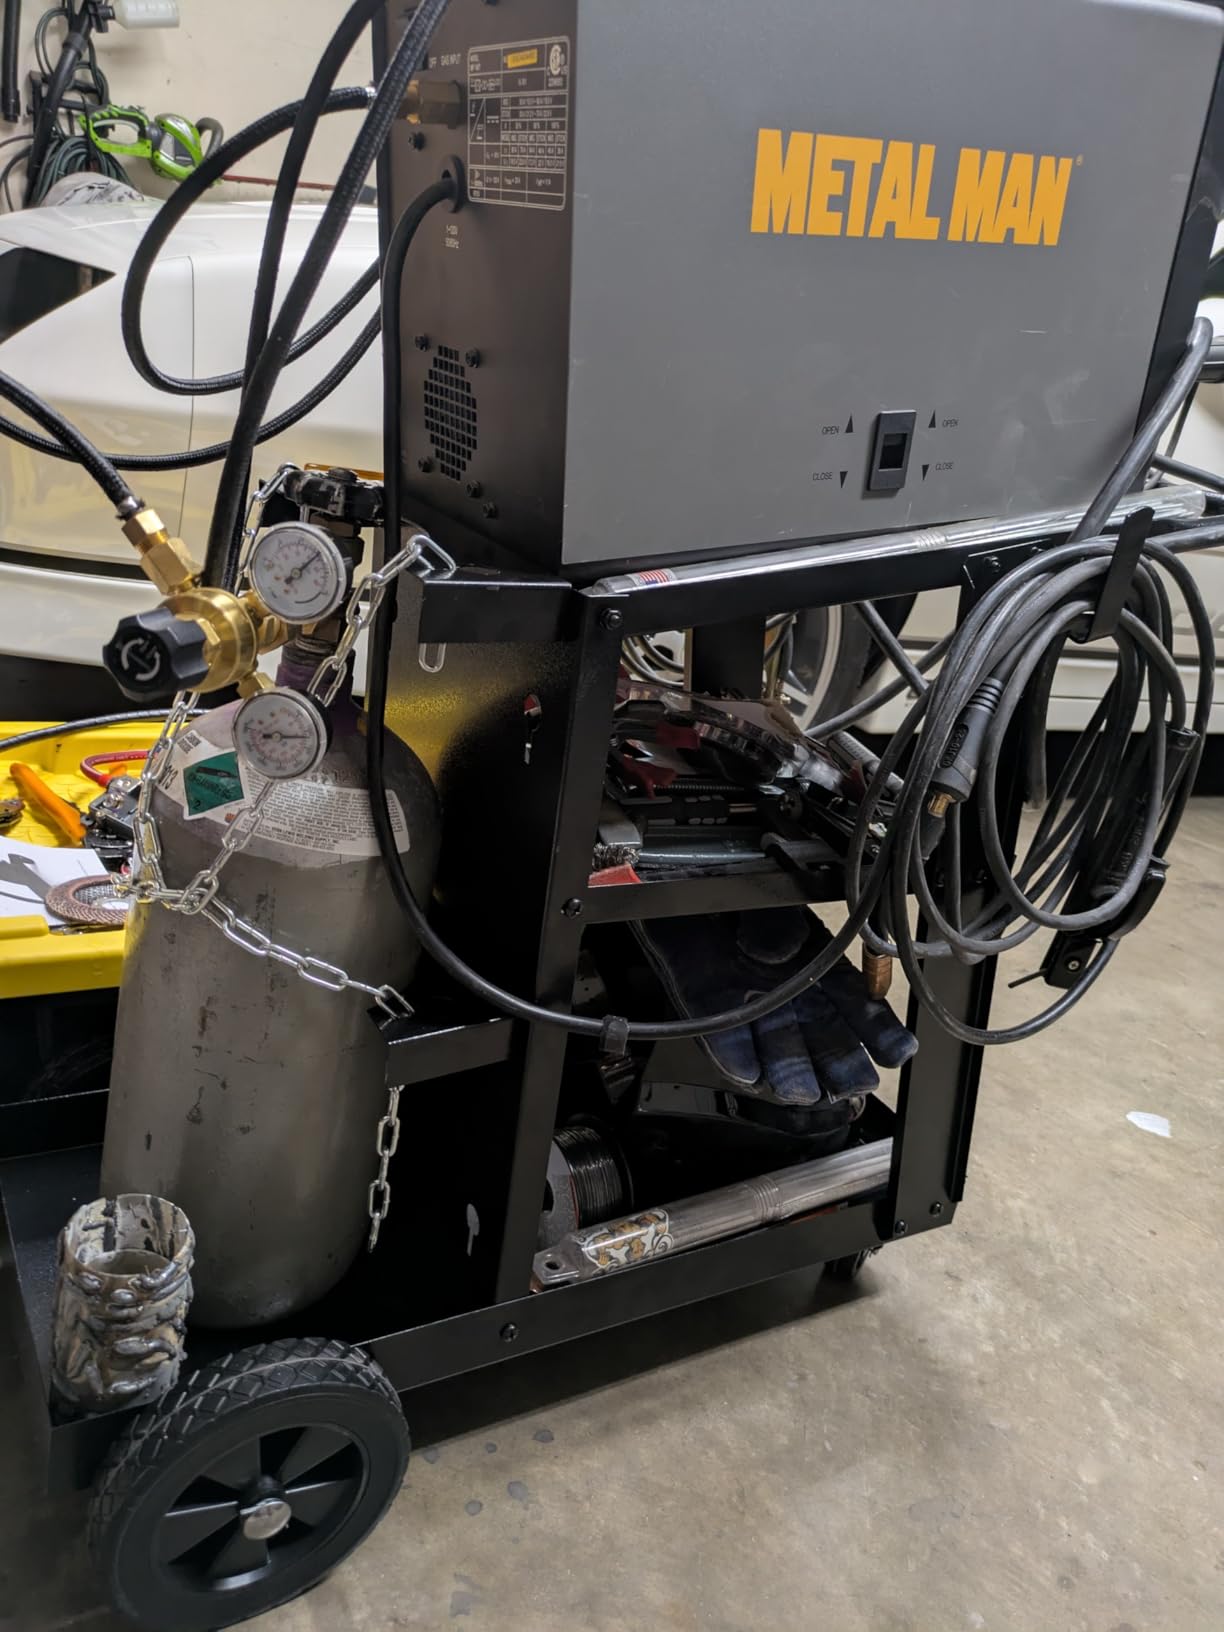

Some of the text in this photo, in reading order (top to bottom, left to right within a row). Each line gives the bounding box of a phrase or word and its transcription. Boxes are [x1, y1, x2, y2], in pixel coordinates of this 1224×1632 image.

[750, 128, 1073, 246] METAL MAN
[941, 418, 959, 428] OPEN
[821, 425, 840, 435] OPEN
[935, 462, 954, 471] CLOSE
[812, 471, 833, 481] CLOSE
